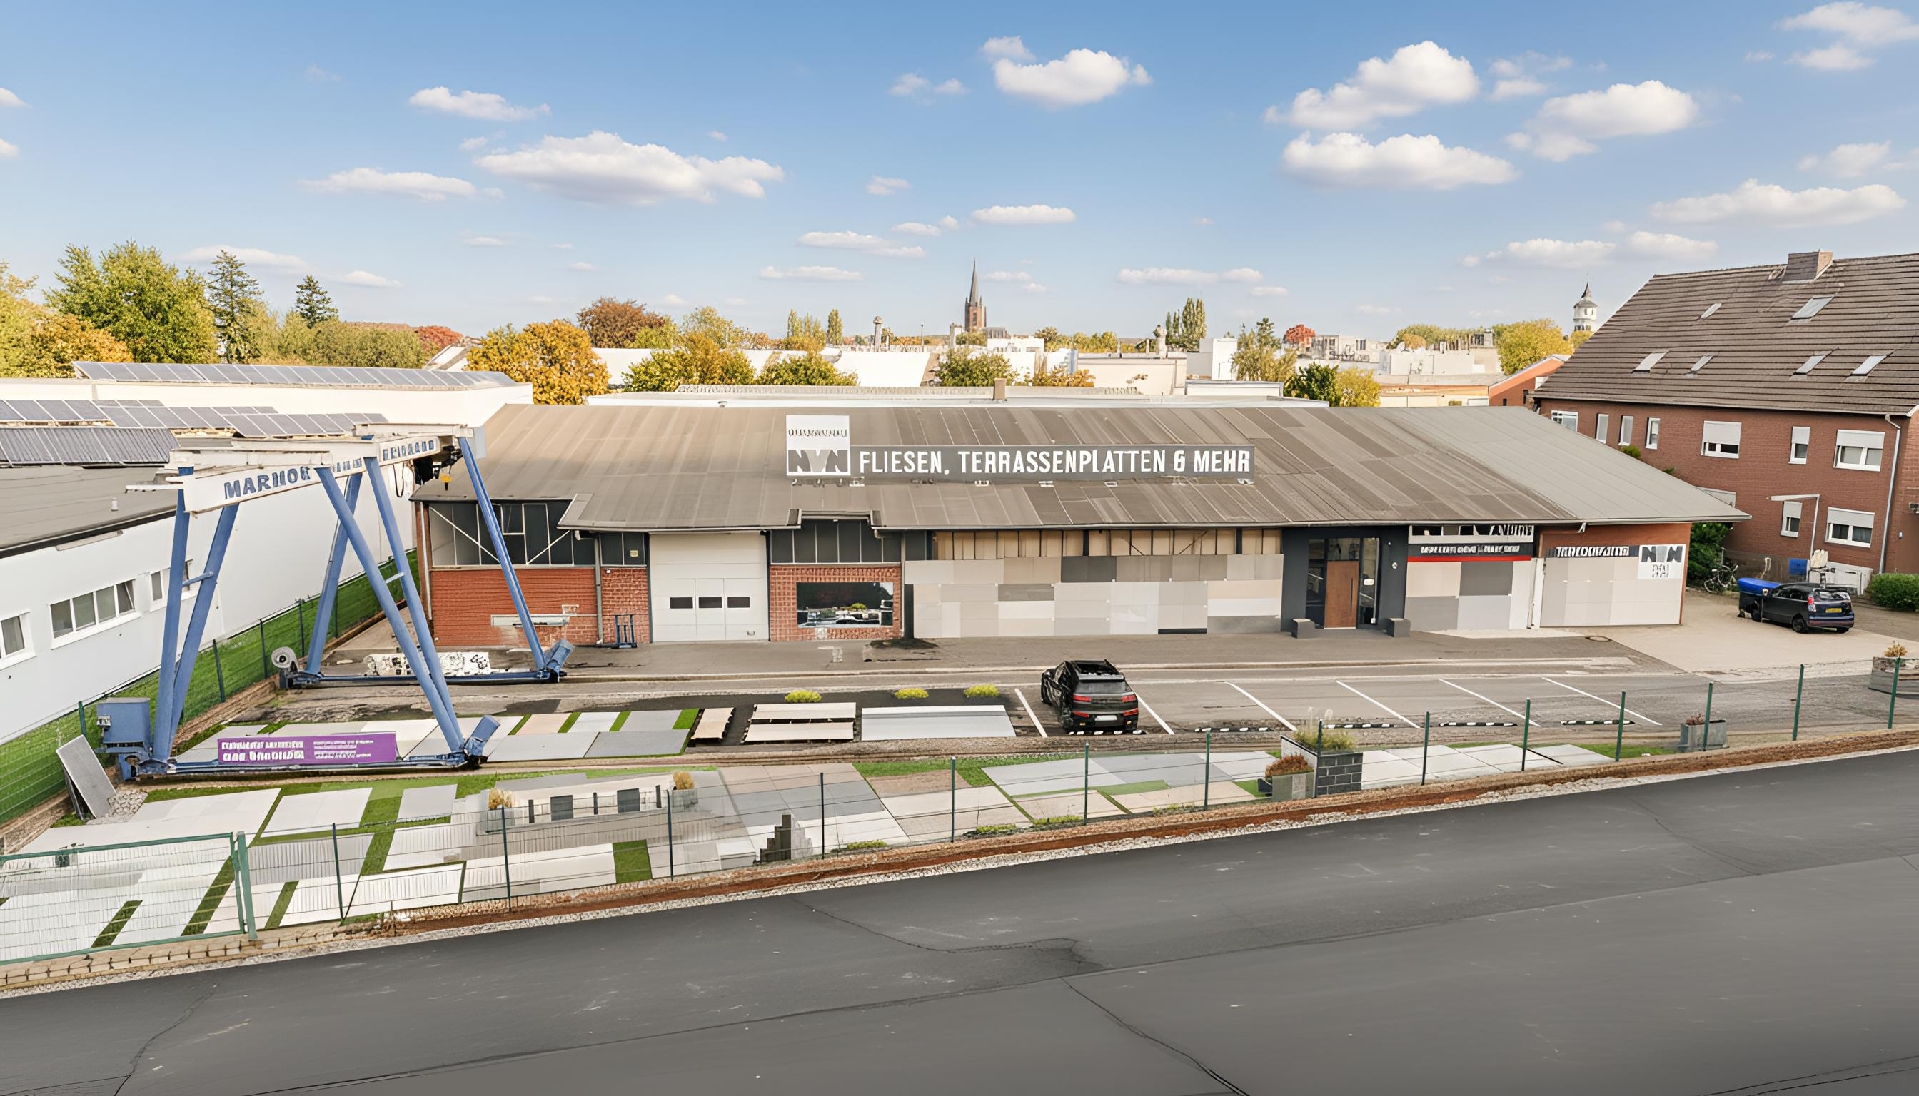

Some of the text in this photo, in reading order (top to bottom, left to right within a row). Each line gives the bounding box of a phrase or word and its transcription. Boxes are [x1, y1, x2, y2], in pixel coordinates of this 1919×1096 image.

[859, 450, 950, 475] FLIESEN,
[957, 449, 1166, 473] TERRASSENPLATTEN
[1193, 450, 1250, 473] MEHR
